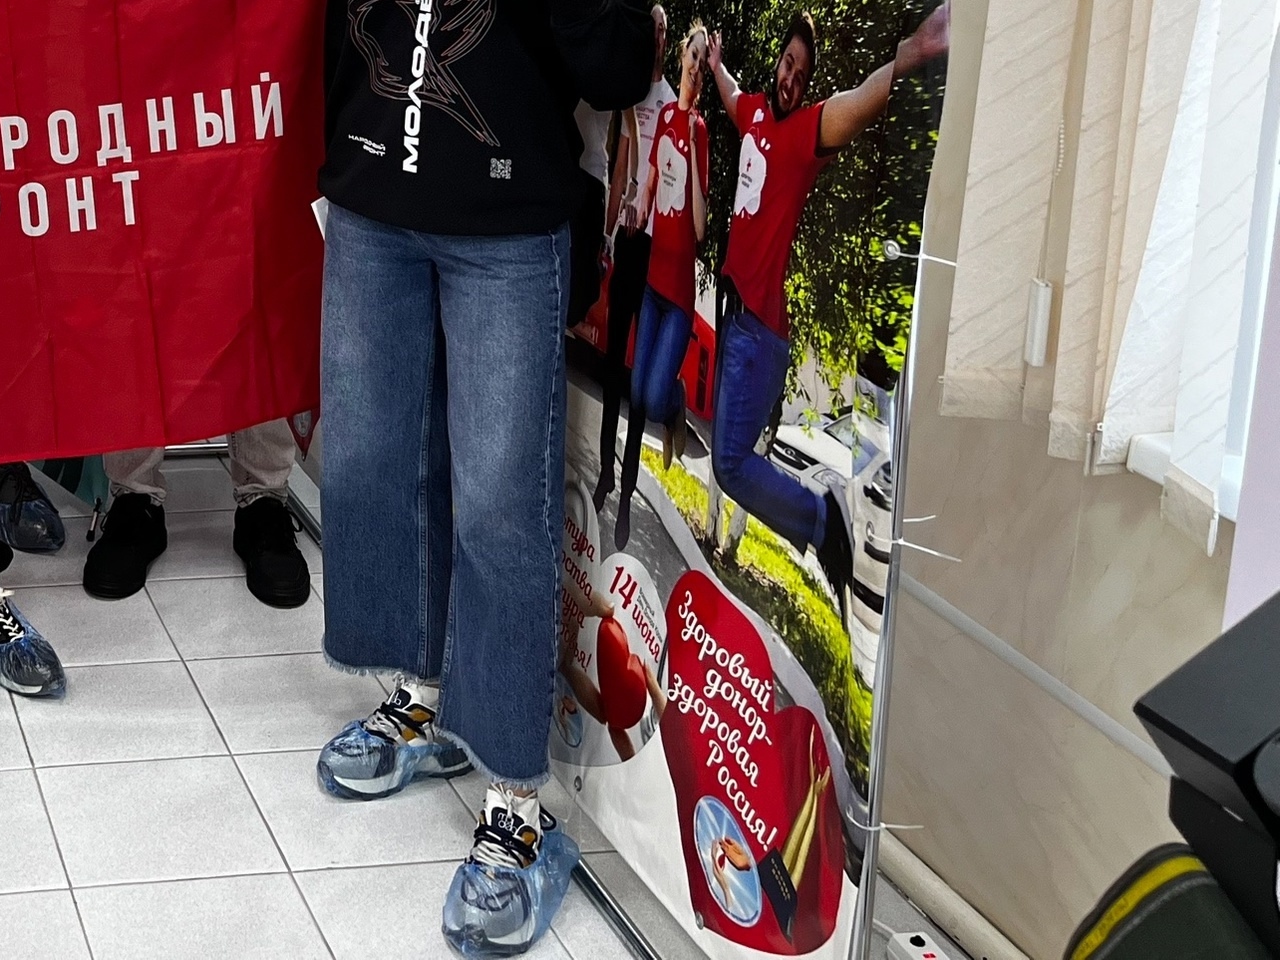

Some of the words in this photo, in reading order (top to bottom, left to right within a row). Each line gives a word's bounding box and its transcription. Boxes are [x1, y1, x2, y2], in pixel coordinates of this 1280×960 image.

[564, 517, 595, 563] тура
[609, 565, 638, 610] 14
[632, 604, 661, 664] июня
[677, 590, 773, 713] Здоровый
[667, 673, 759, 788] здоровая
[703, 668, 773, 746] донор-
[705, 739, 778, 852] Россия!
